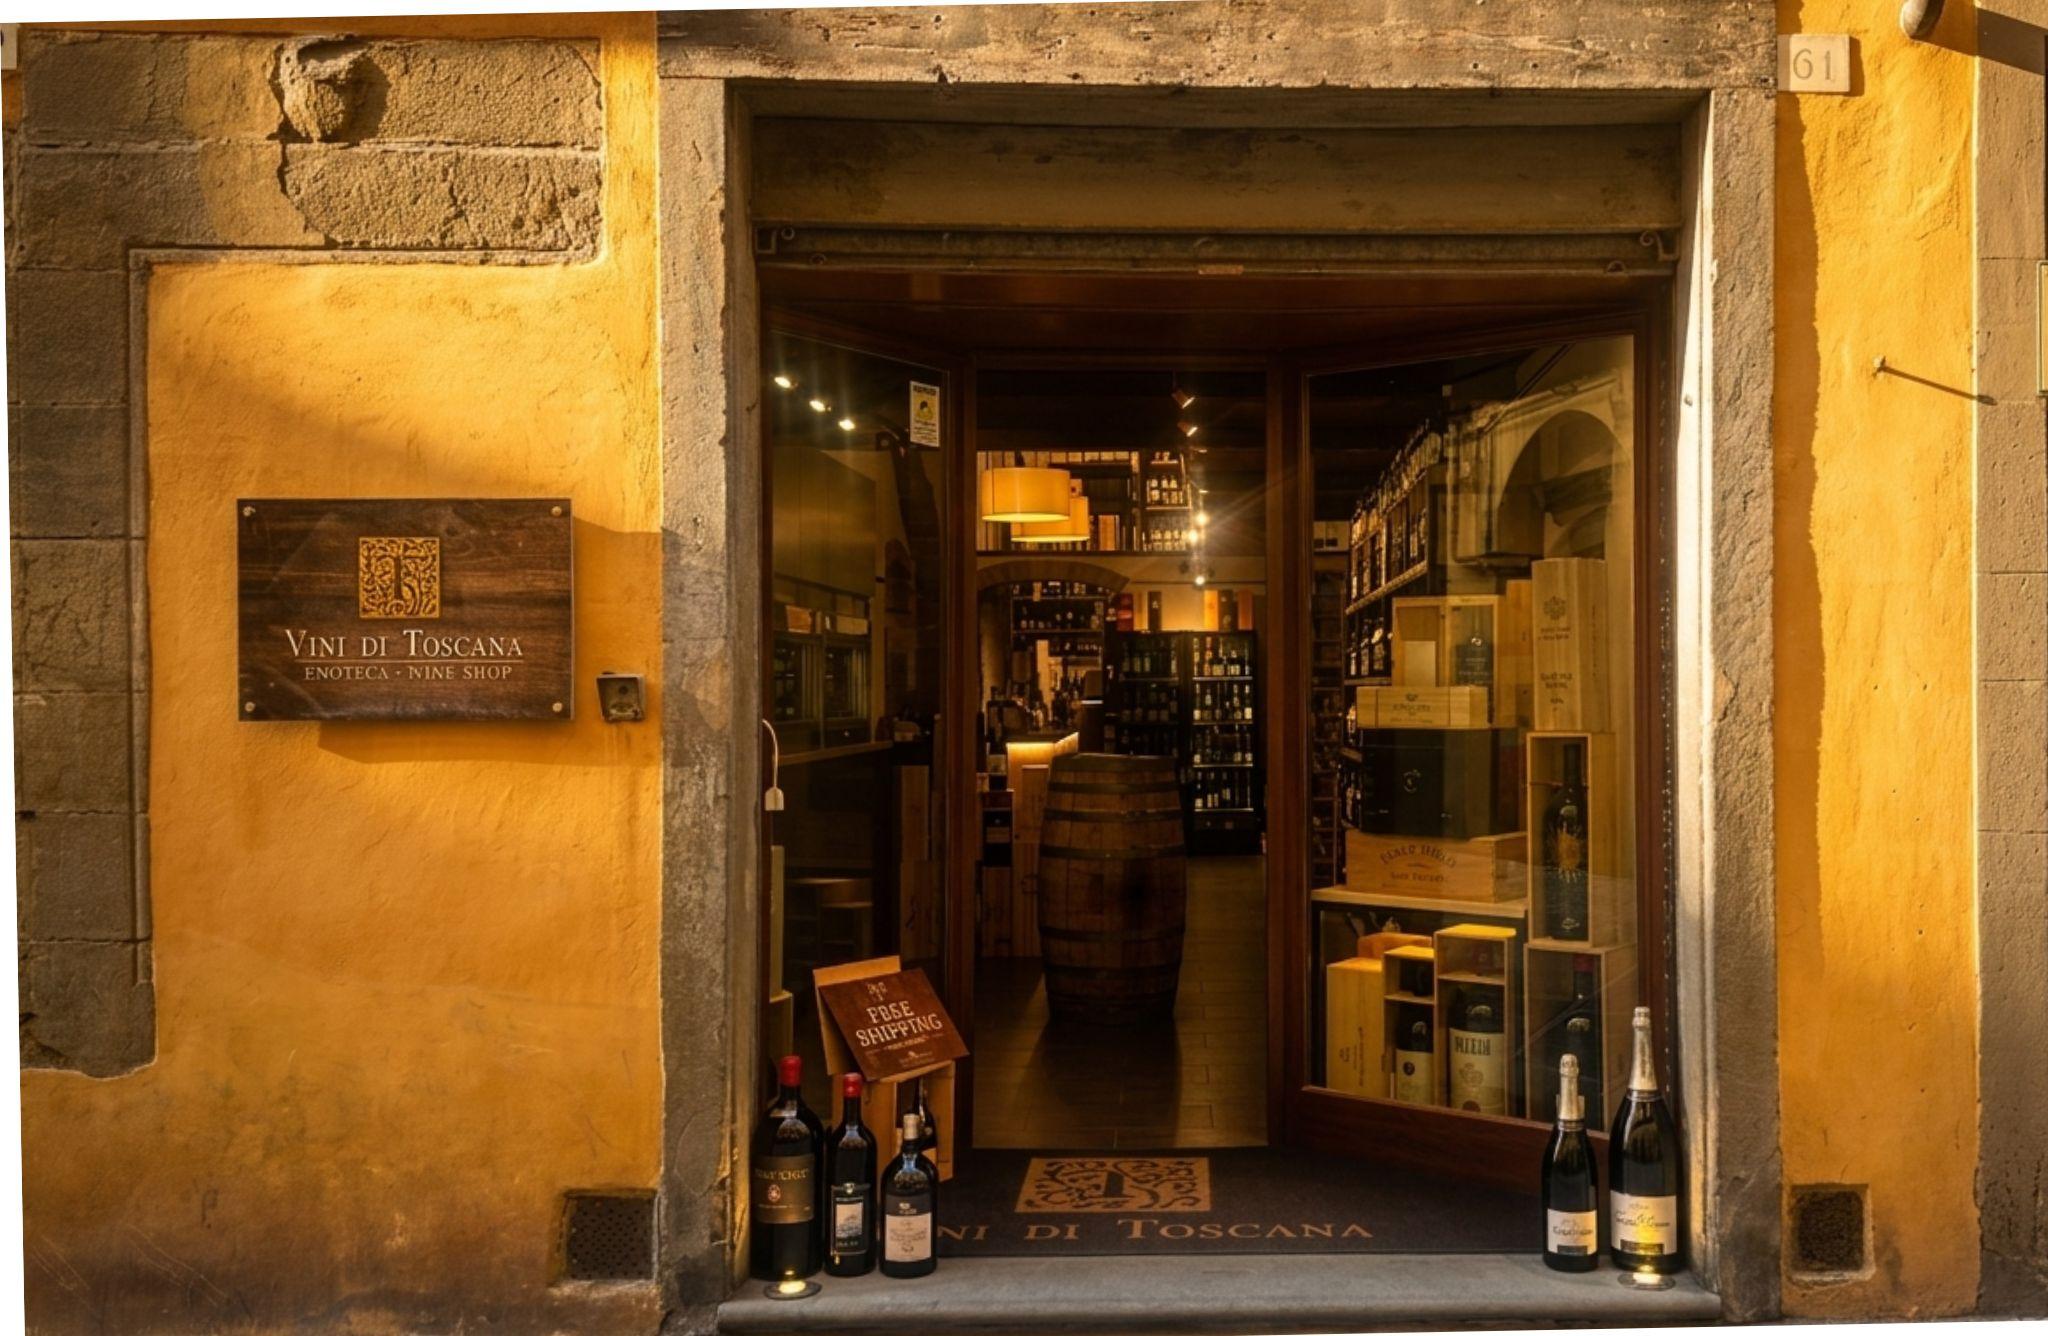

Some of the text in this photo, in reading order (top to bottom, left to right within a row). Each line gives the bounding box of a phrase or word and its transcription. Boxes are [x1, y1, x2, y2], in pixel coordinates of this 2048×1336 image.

[1793, 48, 1831, 80] 61
[285, 629, 523, 657] VINI DI TOSCANA
[305, 666, 389, 680] ENOTECA
[463, 666, 512, 680] SHOP
[937, 1224, 990, 1240] NI
[1024, 1224, 1081, 1240] DI
[1117, 1219, 1374, 1240] TOSCANA
